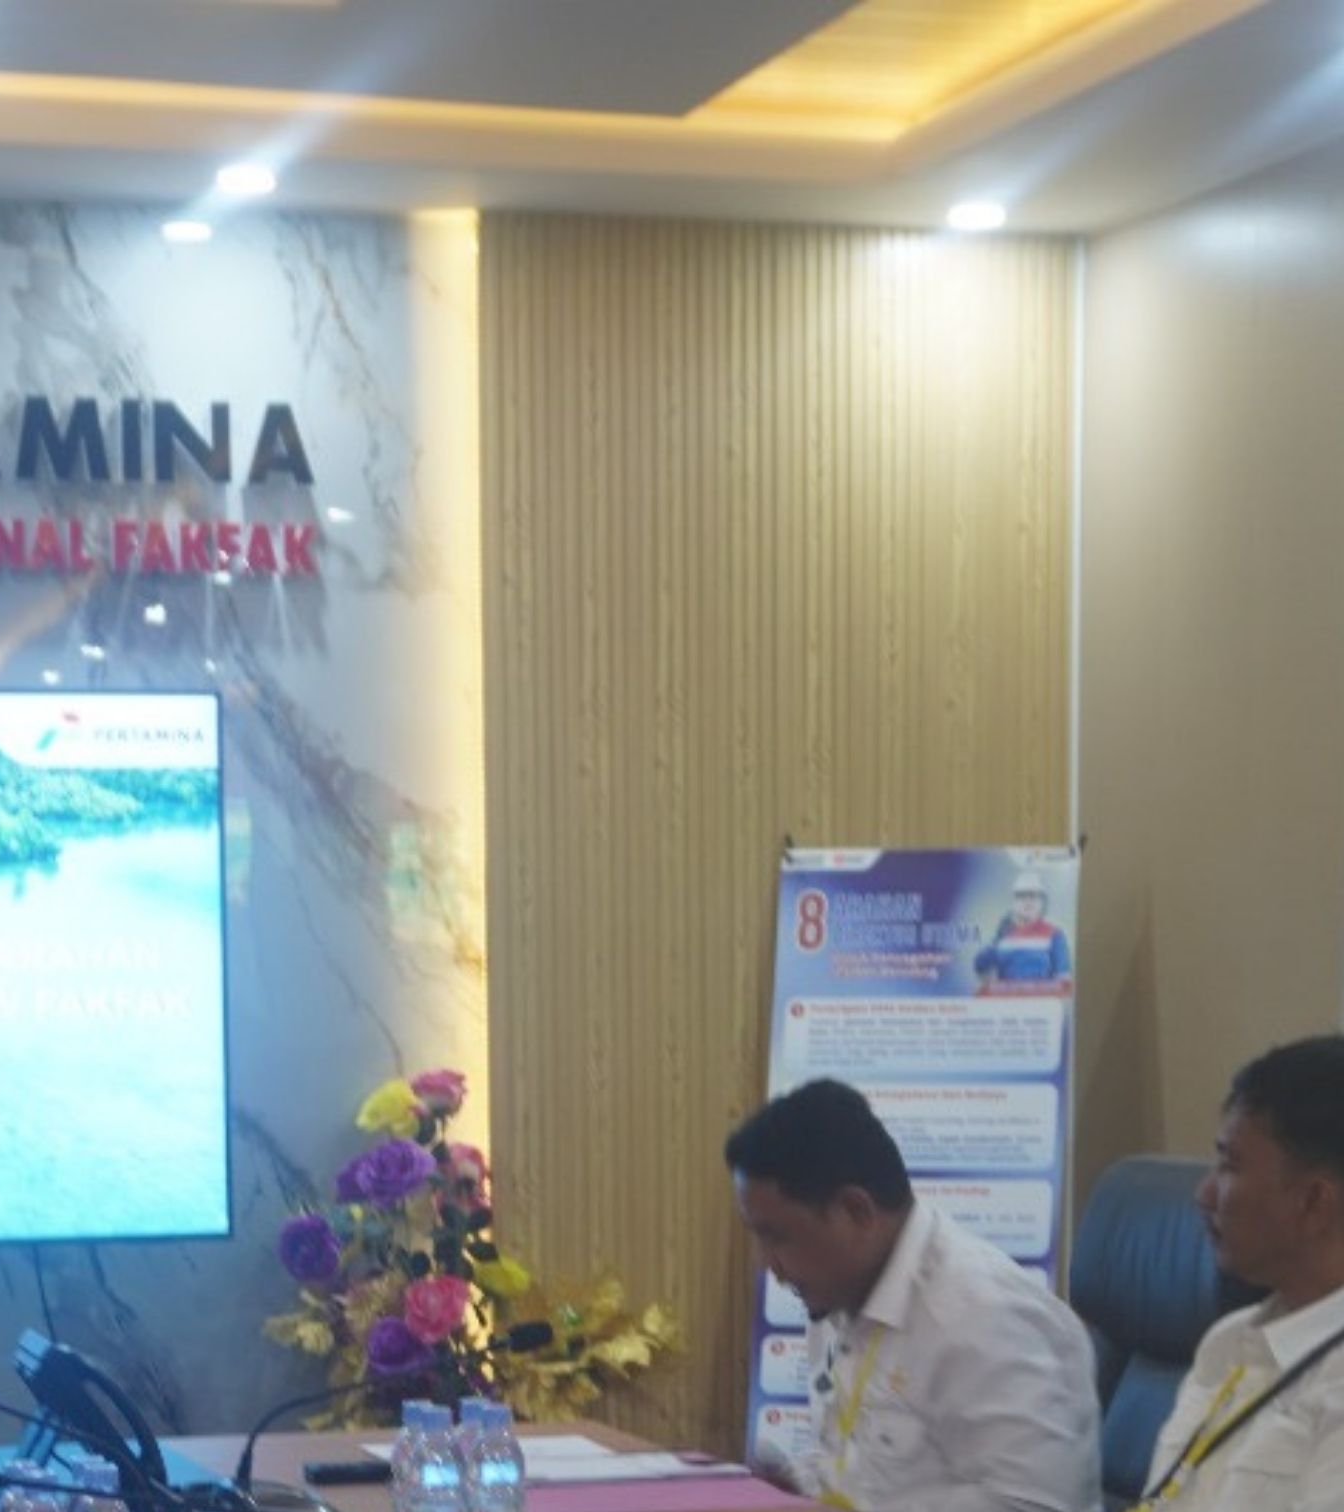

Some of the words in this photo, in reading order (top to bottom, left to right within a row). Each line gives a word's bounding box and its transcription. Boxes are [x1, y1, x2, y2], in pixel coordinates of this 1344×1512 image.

[112, 518, 318, 574] FAKFAK
[93, 726, 206, 744] PERTAMINA
[795, 888, 828, 951] 8
